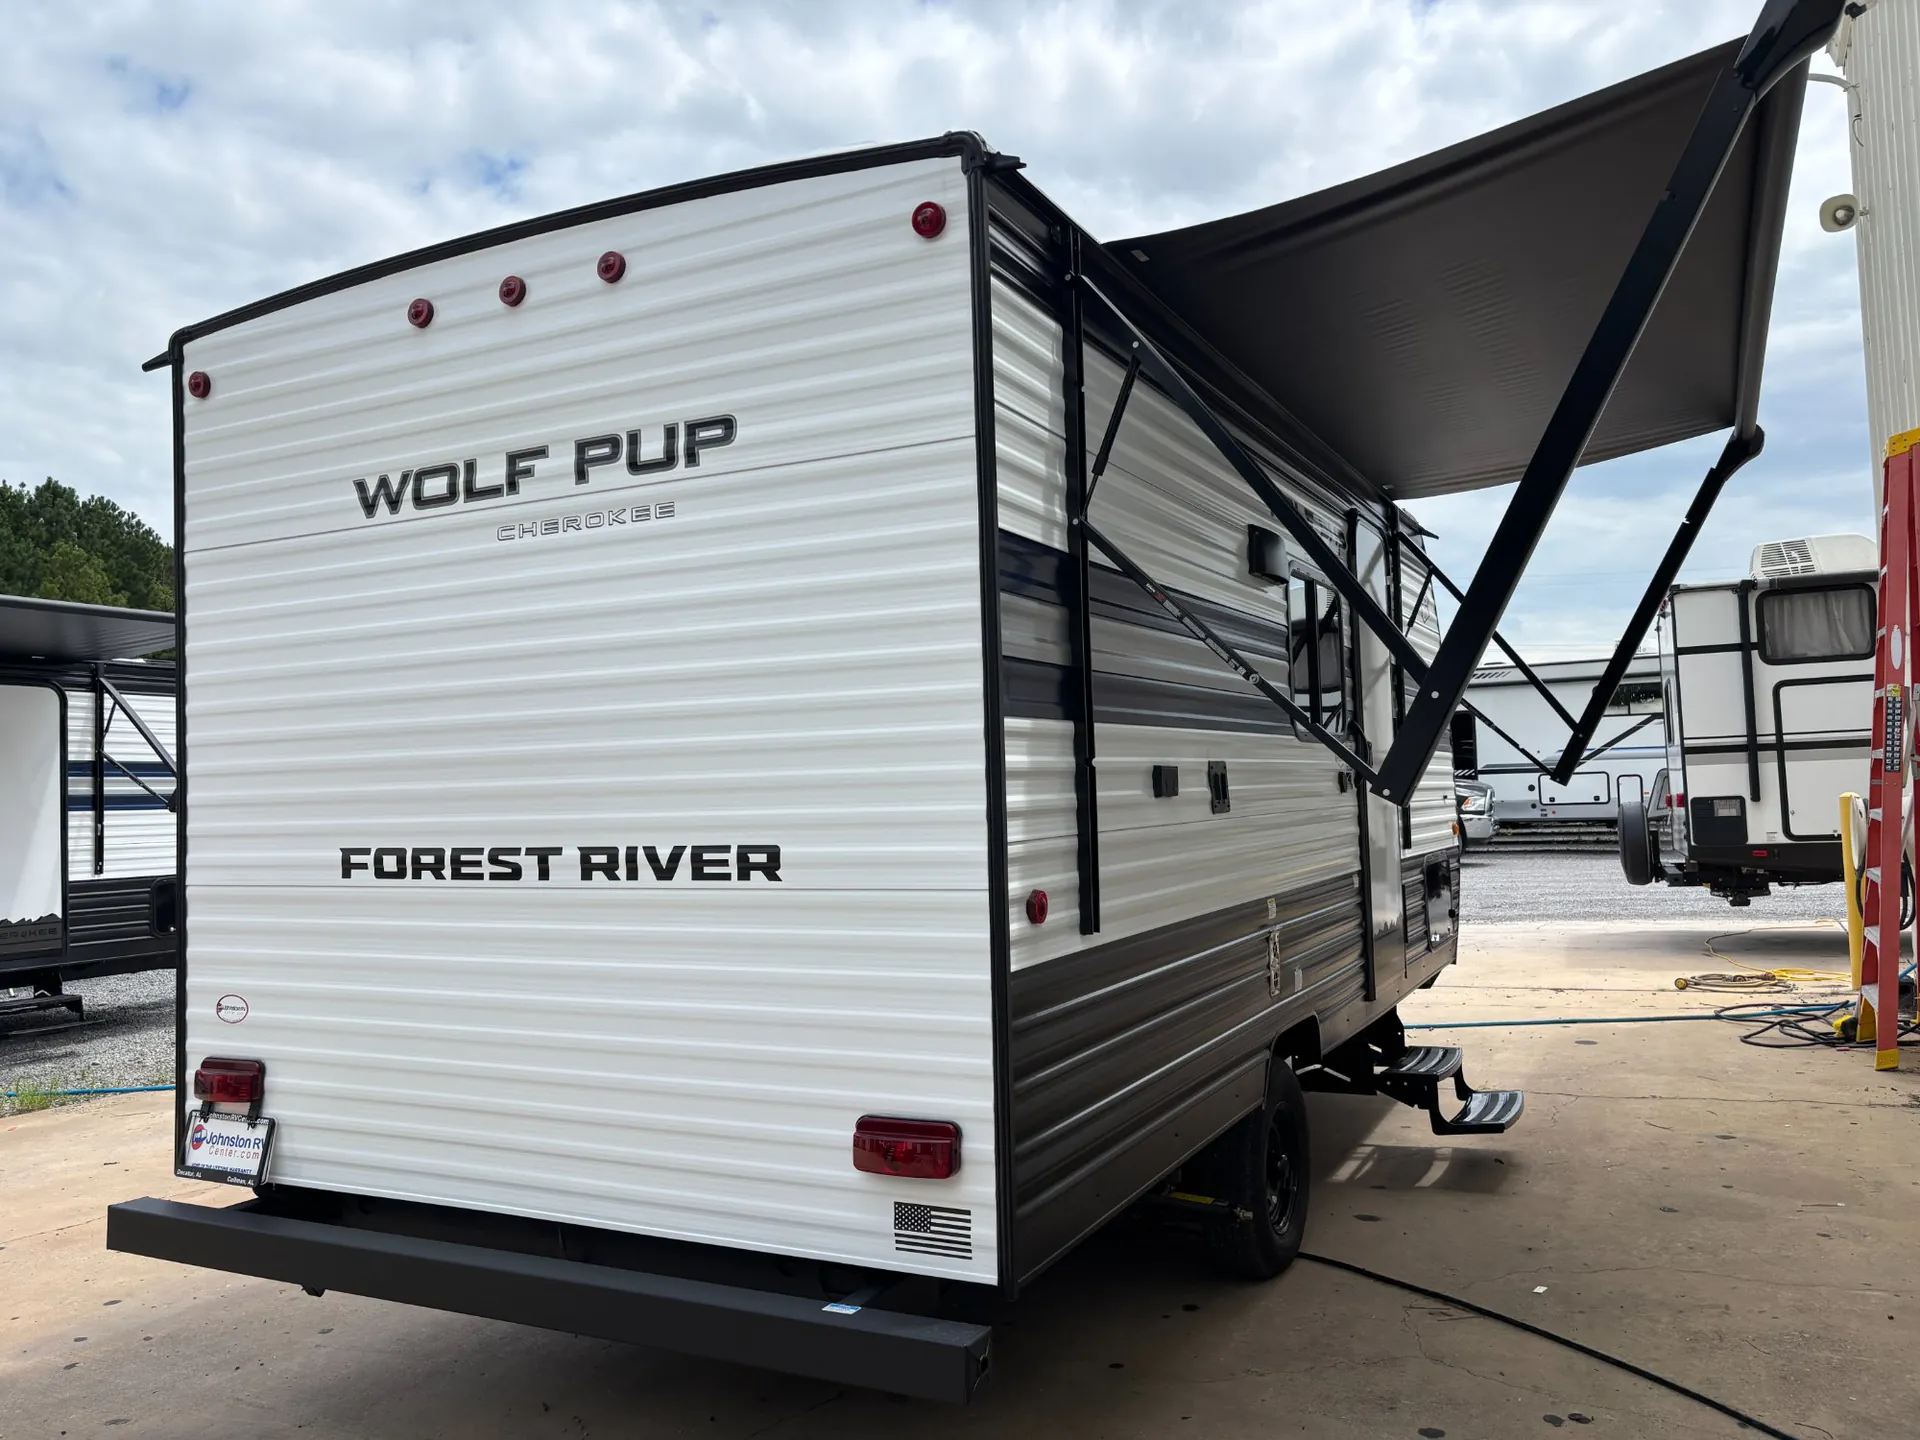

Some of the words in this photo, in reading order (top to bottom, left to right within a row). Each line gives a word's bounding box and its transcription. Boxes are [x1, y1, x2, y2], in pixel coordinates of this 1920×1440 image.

[353, 445, 549, 519] WOLF
[574, 414, 737, 485] PUP
[497, 501, 675, 541] CHEROKEE
[339, 846, 563, 881] FOREST
[577, 844, 783, 881] RIVER
[206, 1132, 251, 1148] Johnston
[208, 1145, 260, 1160] Center.com
